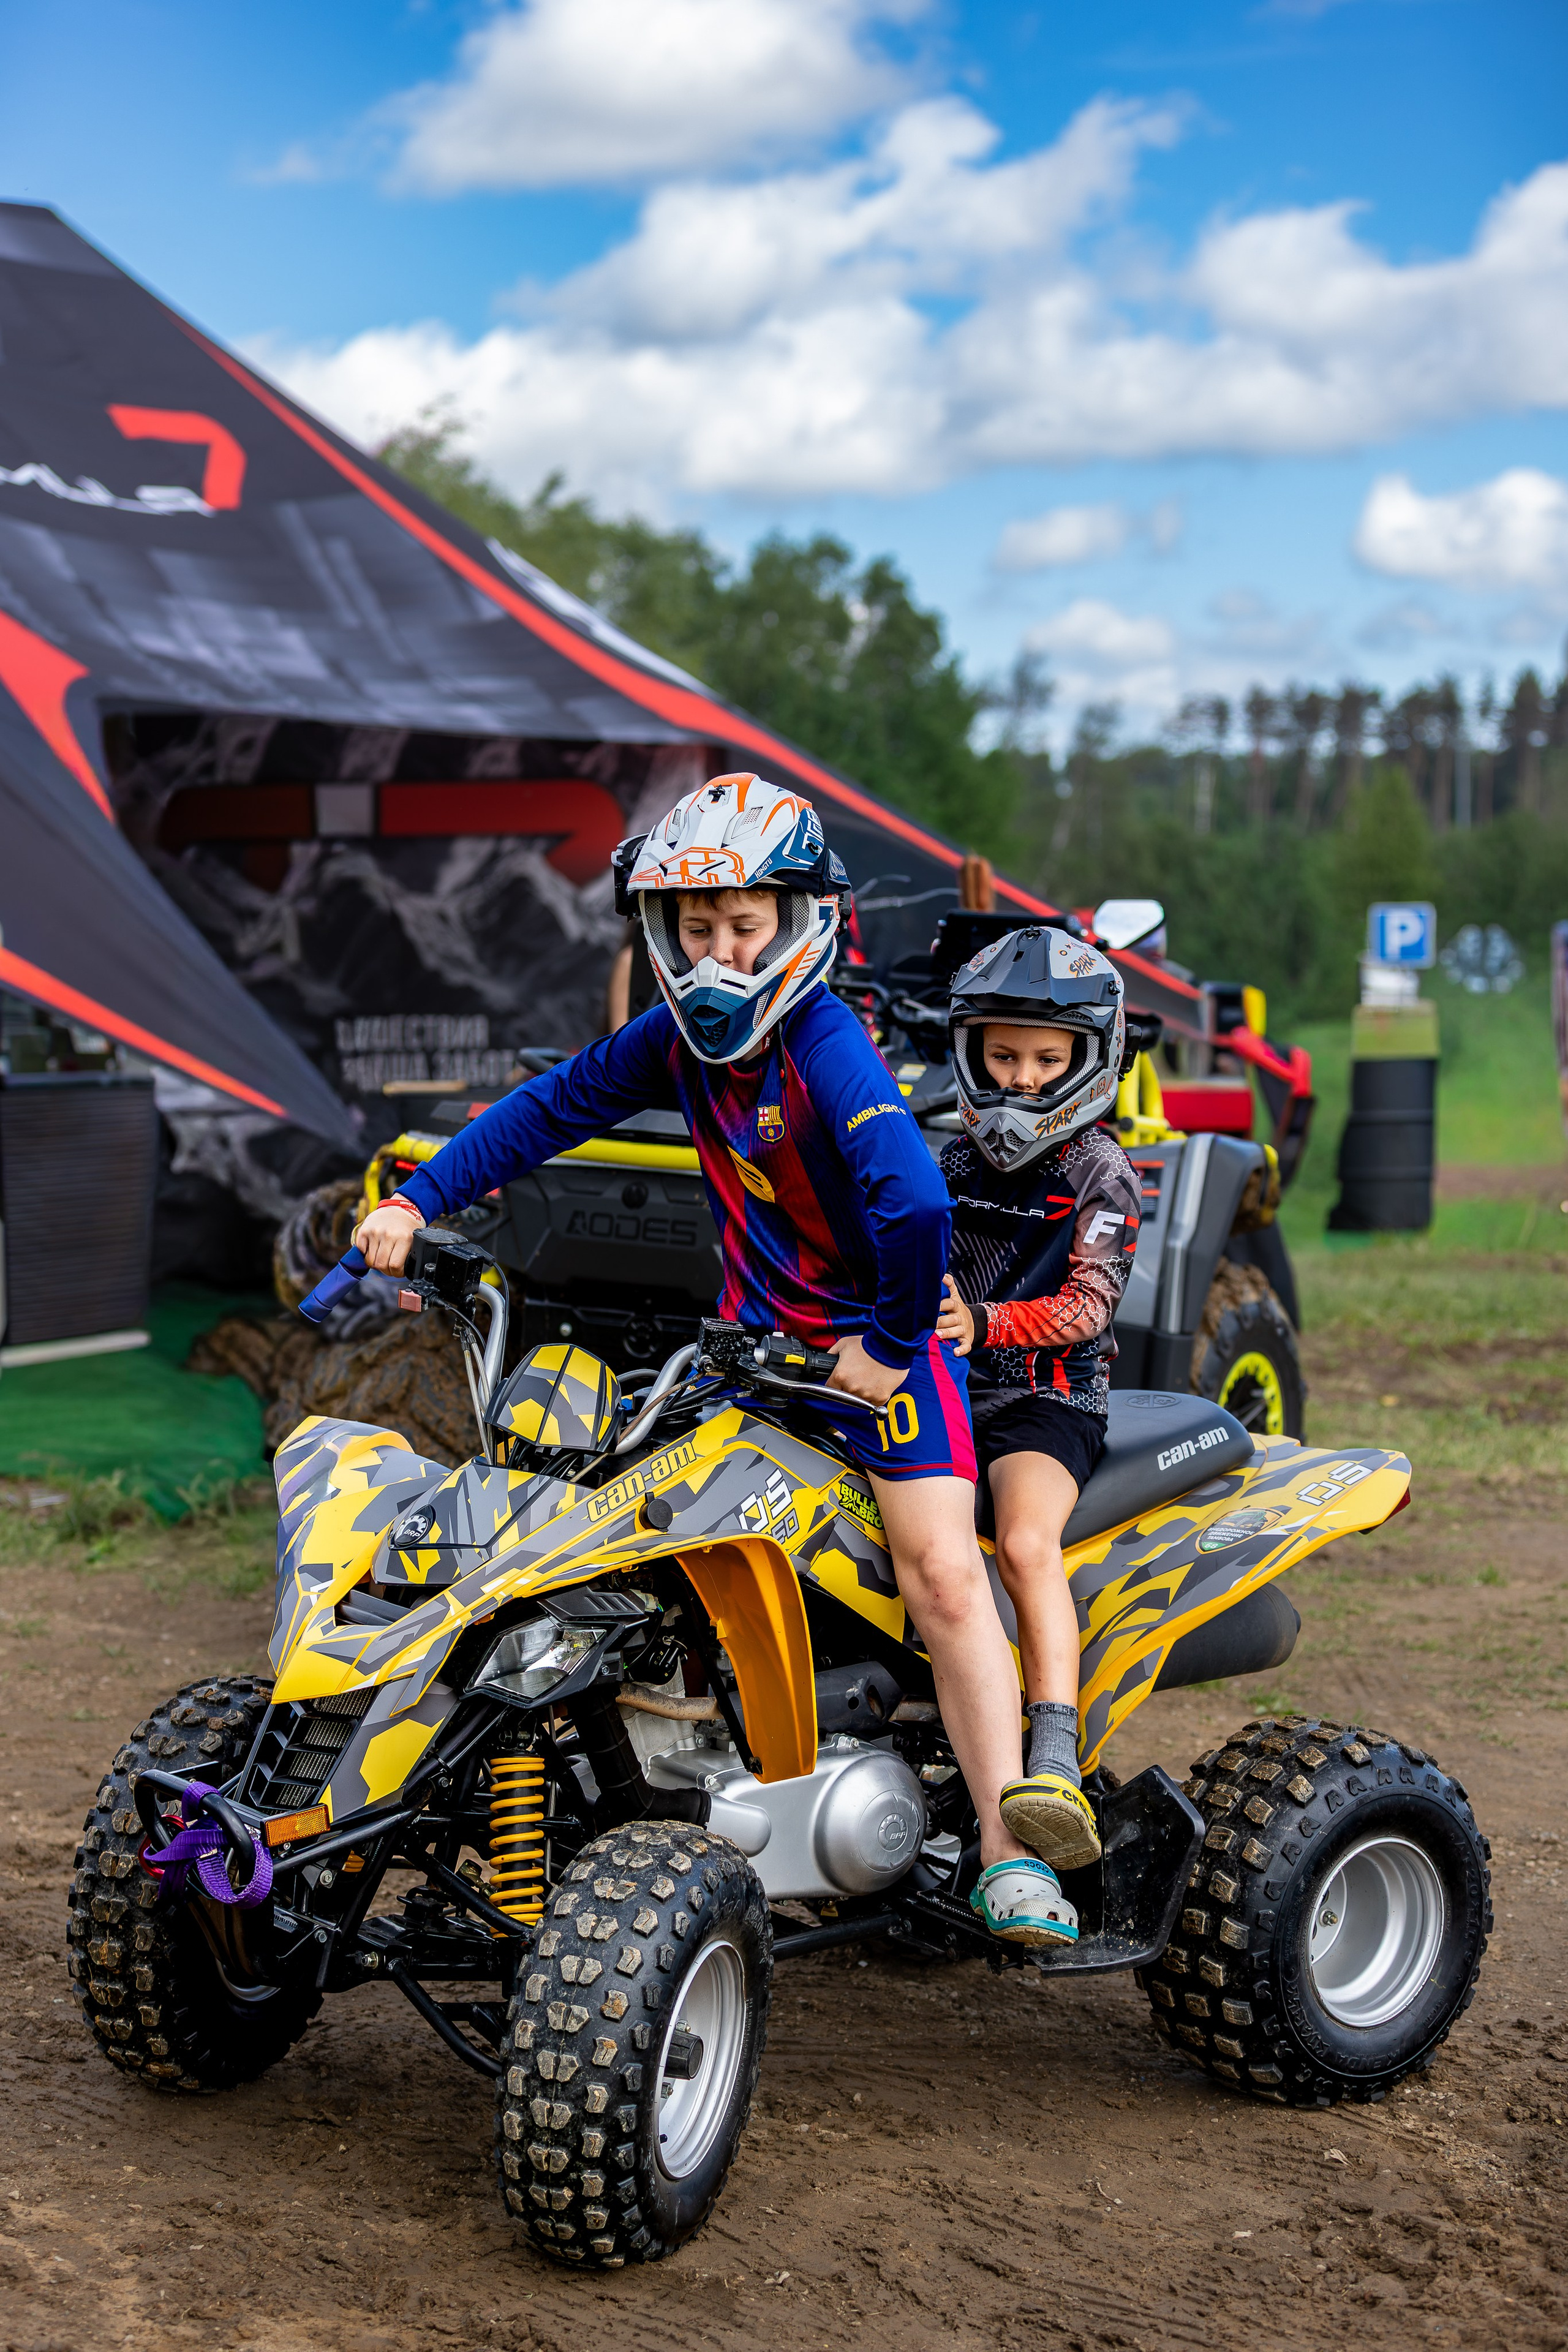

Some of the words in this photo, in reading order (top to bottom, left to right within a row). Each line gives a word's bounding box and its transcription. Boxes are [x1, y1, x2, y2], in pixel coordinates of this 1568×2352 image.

[754, 857, 774, 879] HONGTU
[1383, 907, 1425, 957] P
[846, 1104, 900, 1133] AMBILIGHT
[1034, 1101, 1082, 1140] SPARX
[566, 1209, 698, 1246] AODES
[1157, 1426, 1229, 1471] can-am
[586, 1441, 698, 1523] can-am
[840, 1483, 881, 1517] BULLE
[404, 1529, 421, 1537] BRP
[767, 1507, 799, 1545] 50
[1207, 1527, 1255, 1536] ВНЕДОРОЖНОЕ
[1024, 1860, 1049, 1874] crocs
